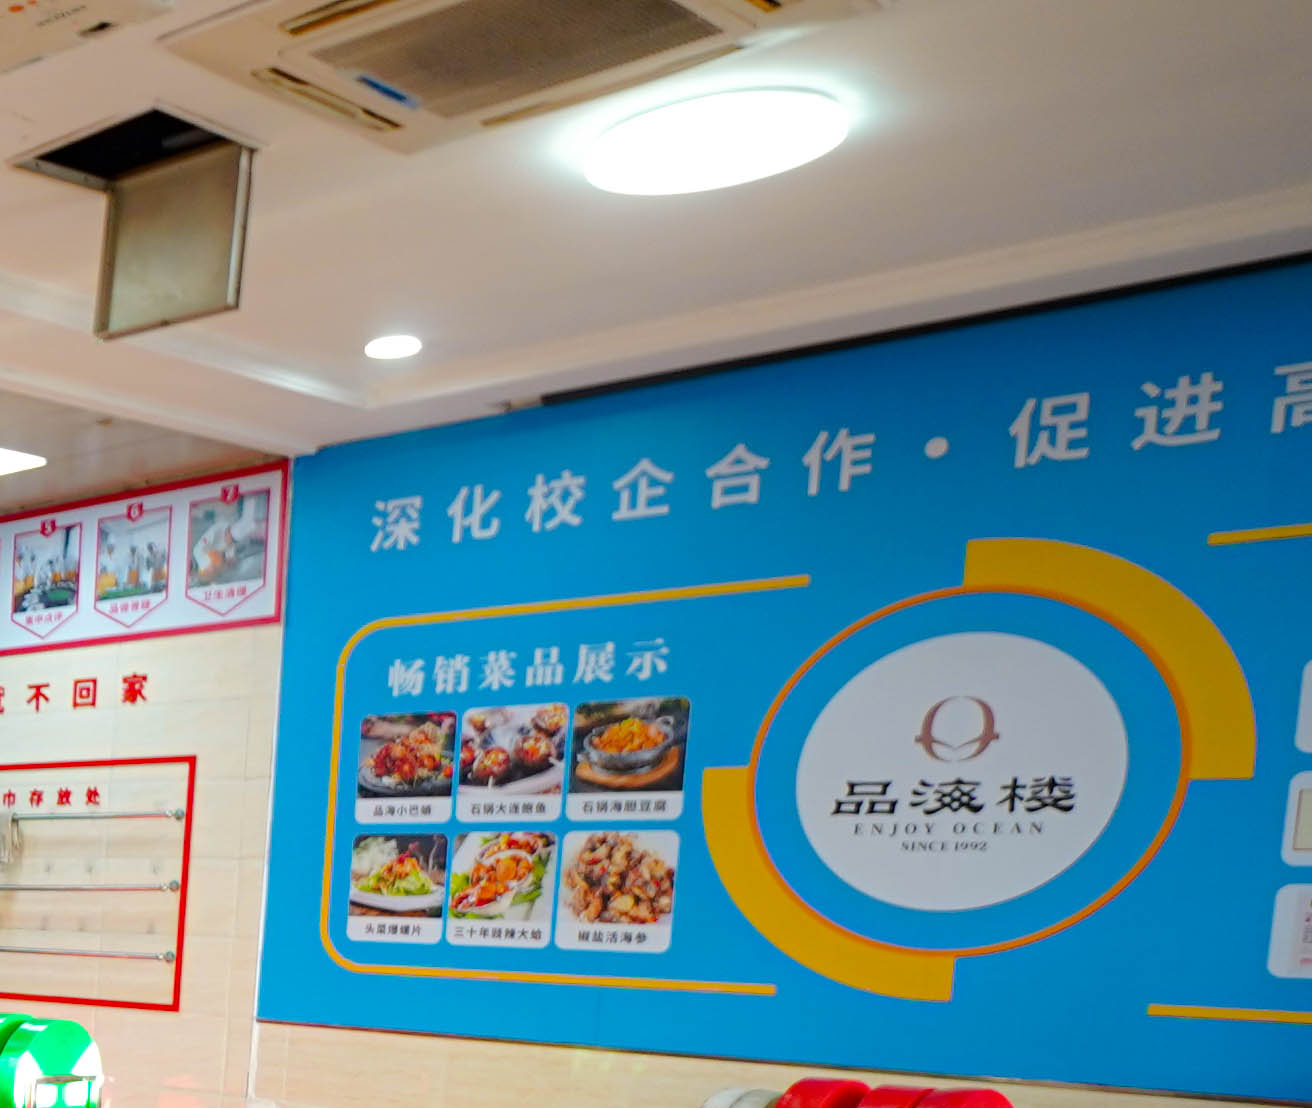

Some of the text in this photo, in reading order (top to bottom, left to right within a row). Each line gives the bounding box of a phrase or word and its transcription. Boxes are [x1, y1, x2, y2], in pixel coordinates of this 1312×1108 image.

[387, 637, 671, 697] 畅销菜品展示
[852, 820, 1047, 838] ENJOY OCEAN
[900, 839, 989, 852] SINCE 1992
